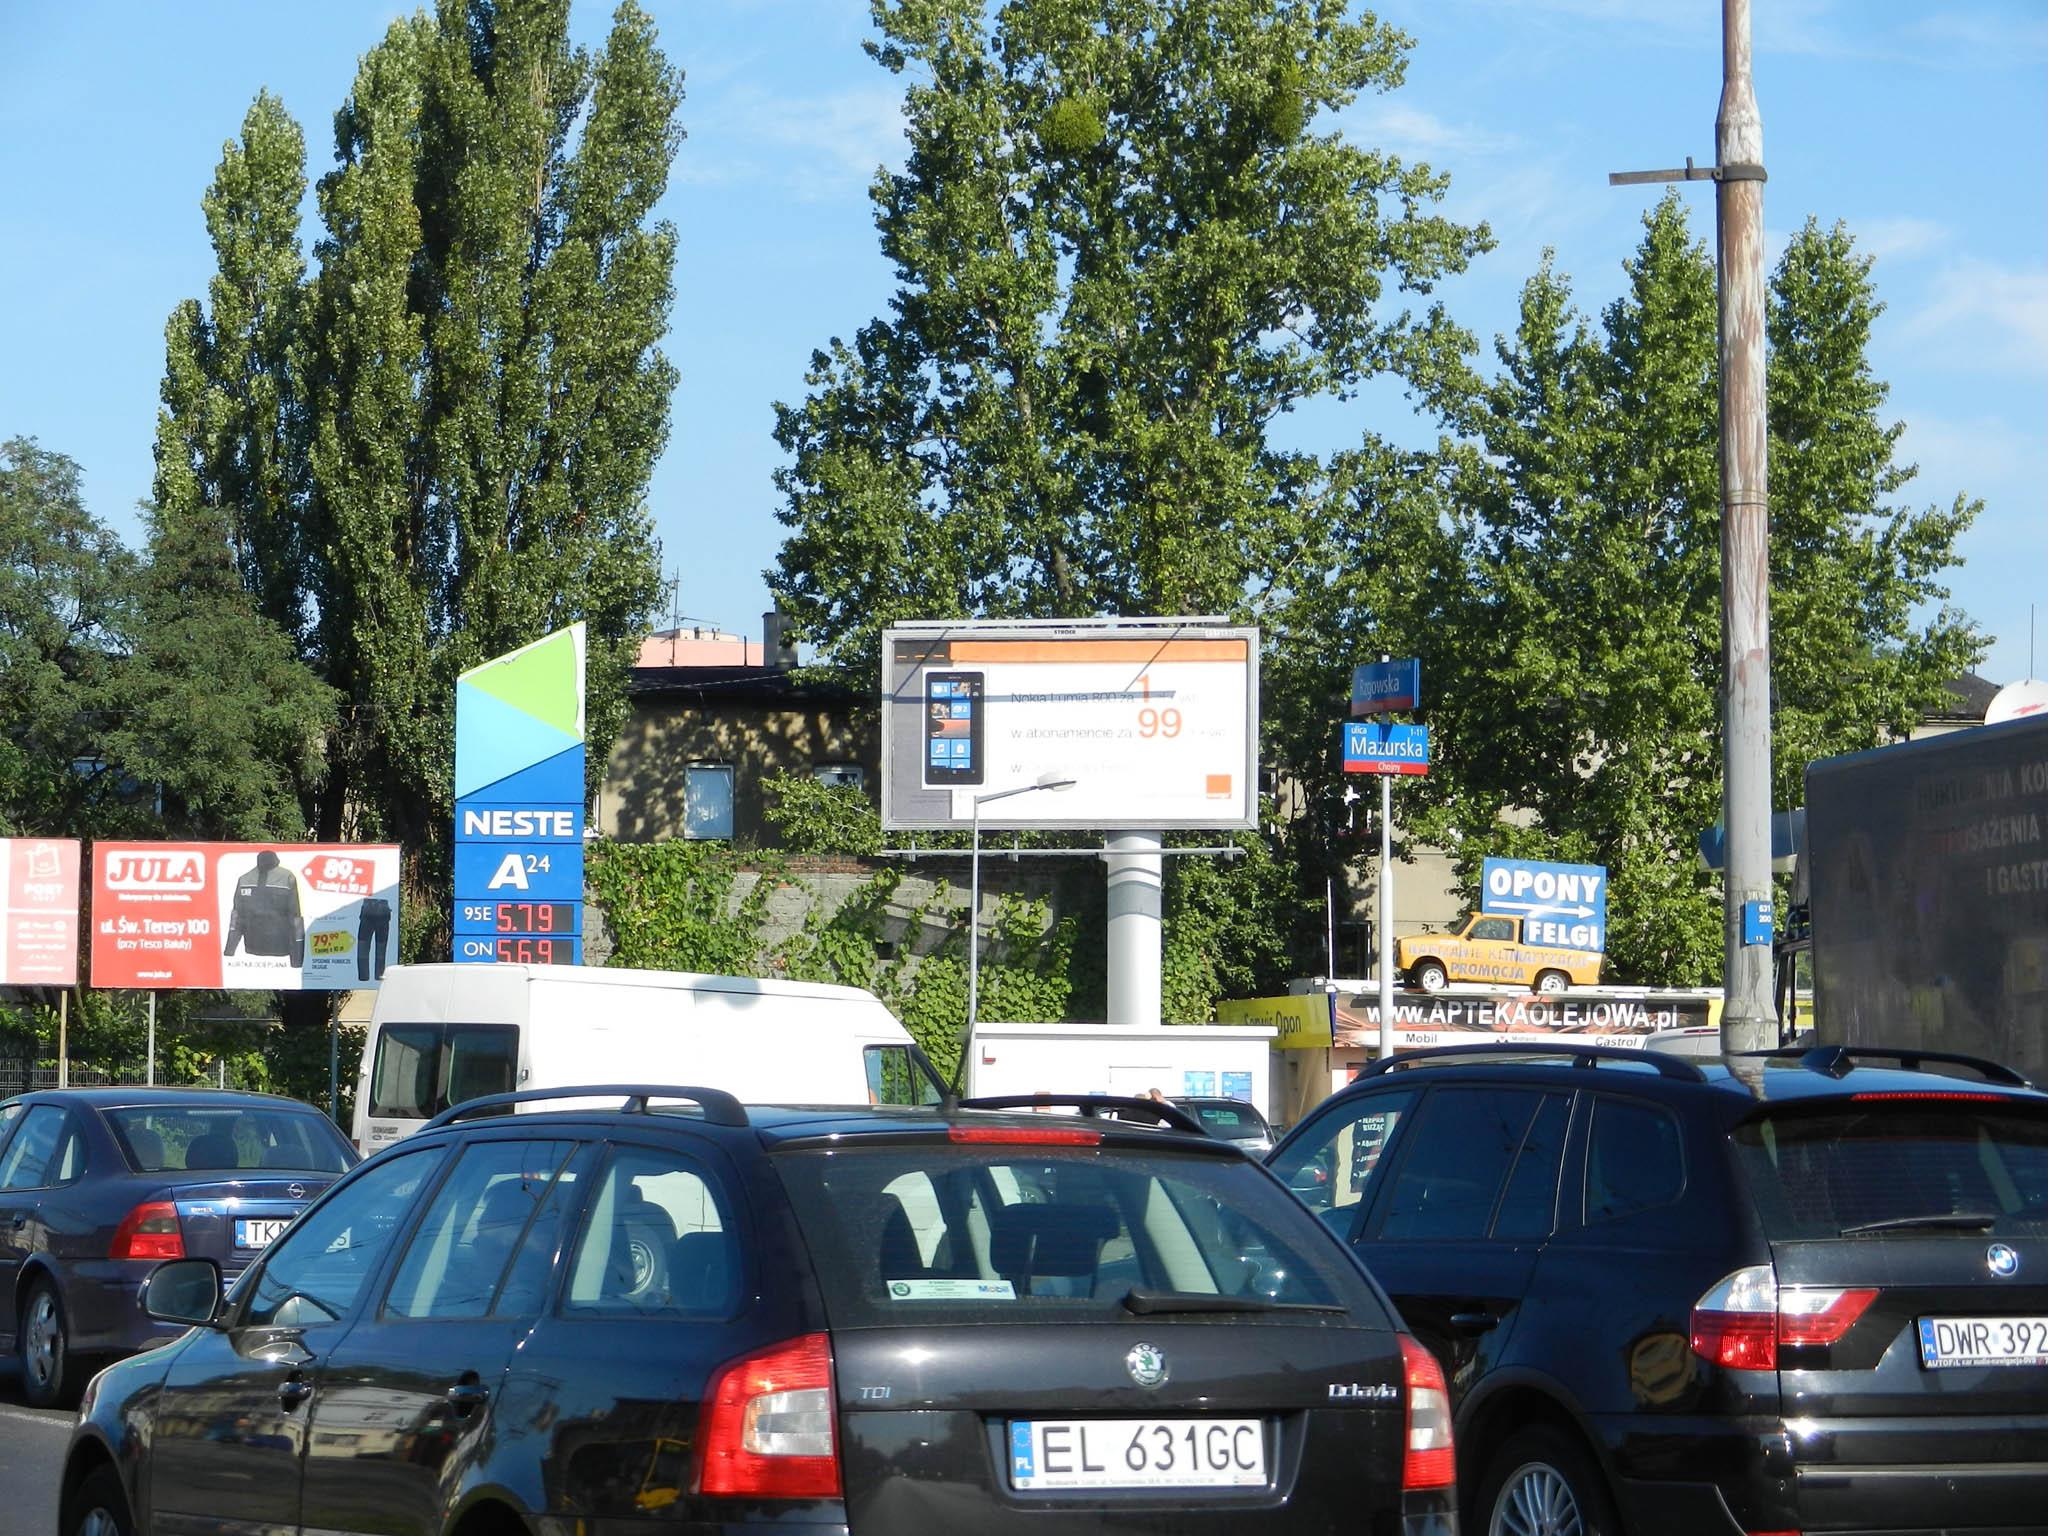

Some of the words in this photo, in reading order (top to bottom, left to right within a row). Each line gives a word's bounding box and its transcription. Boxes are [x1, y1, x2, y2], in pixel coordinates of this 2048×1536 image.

[1011, 692, 1046, 703] Nokia
[1050, 691, 1088, 703] Lumia
[1092, 691, 1116, 703] 800
[1026, 727, 1112, 738] abonamencie
[1117, 729, 1132, 738] za
[1138, 708, 1182, 738] 99
[1351, 726, 1367, 735] ulica
[1351, 736, 1423, 757] Mazurska
[1378, 762, 1400, 773] Chojny
[2020, 761, 2048, 795] KO
[464, 811, 574, 836] NESTE
[109, 858, 202, 883] JULA
[1489, 868, 1600, 903] OPONY
[101, 919, 116, 934] ul.
[118, 915, 141, 934] Św.
[143, 918, 185, 936] Teresy
[187, 919, 210, 934] 100
[464, 907, 492, 921] 95E
[497, 904, 552, 932] 5.79
[139, 939, 162, 949] Tesco
[1528, 920, 1598, 949] FELGI
[464, 942, 493, 956] ON
[497, 940, 552, 963] 569
[1450, 962, 1525, 979] PROMOCJA
[1275, 1010, 1302, 1040] Opon
[1406, 1033, 1437, 1044] Mobil
[1595, 1036, 1637, 1048] Castrol
[1926, 1344, 1936, 1353] PL
[1937, 1323, 1991, 1355] DWR
[2000, 1322, 2048, 1355] 392
[860, 1387, 890, 1399] TDI
[1016, 1457, 1032, 1470] PL
[1043, 1426, 1105, 1472] EL
[1126, 1425, 1256, 1471] 631GC
